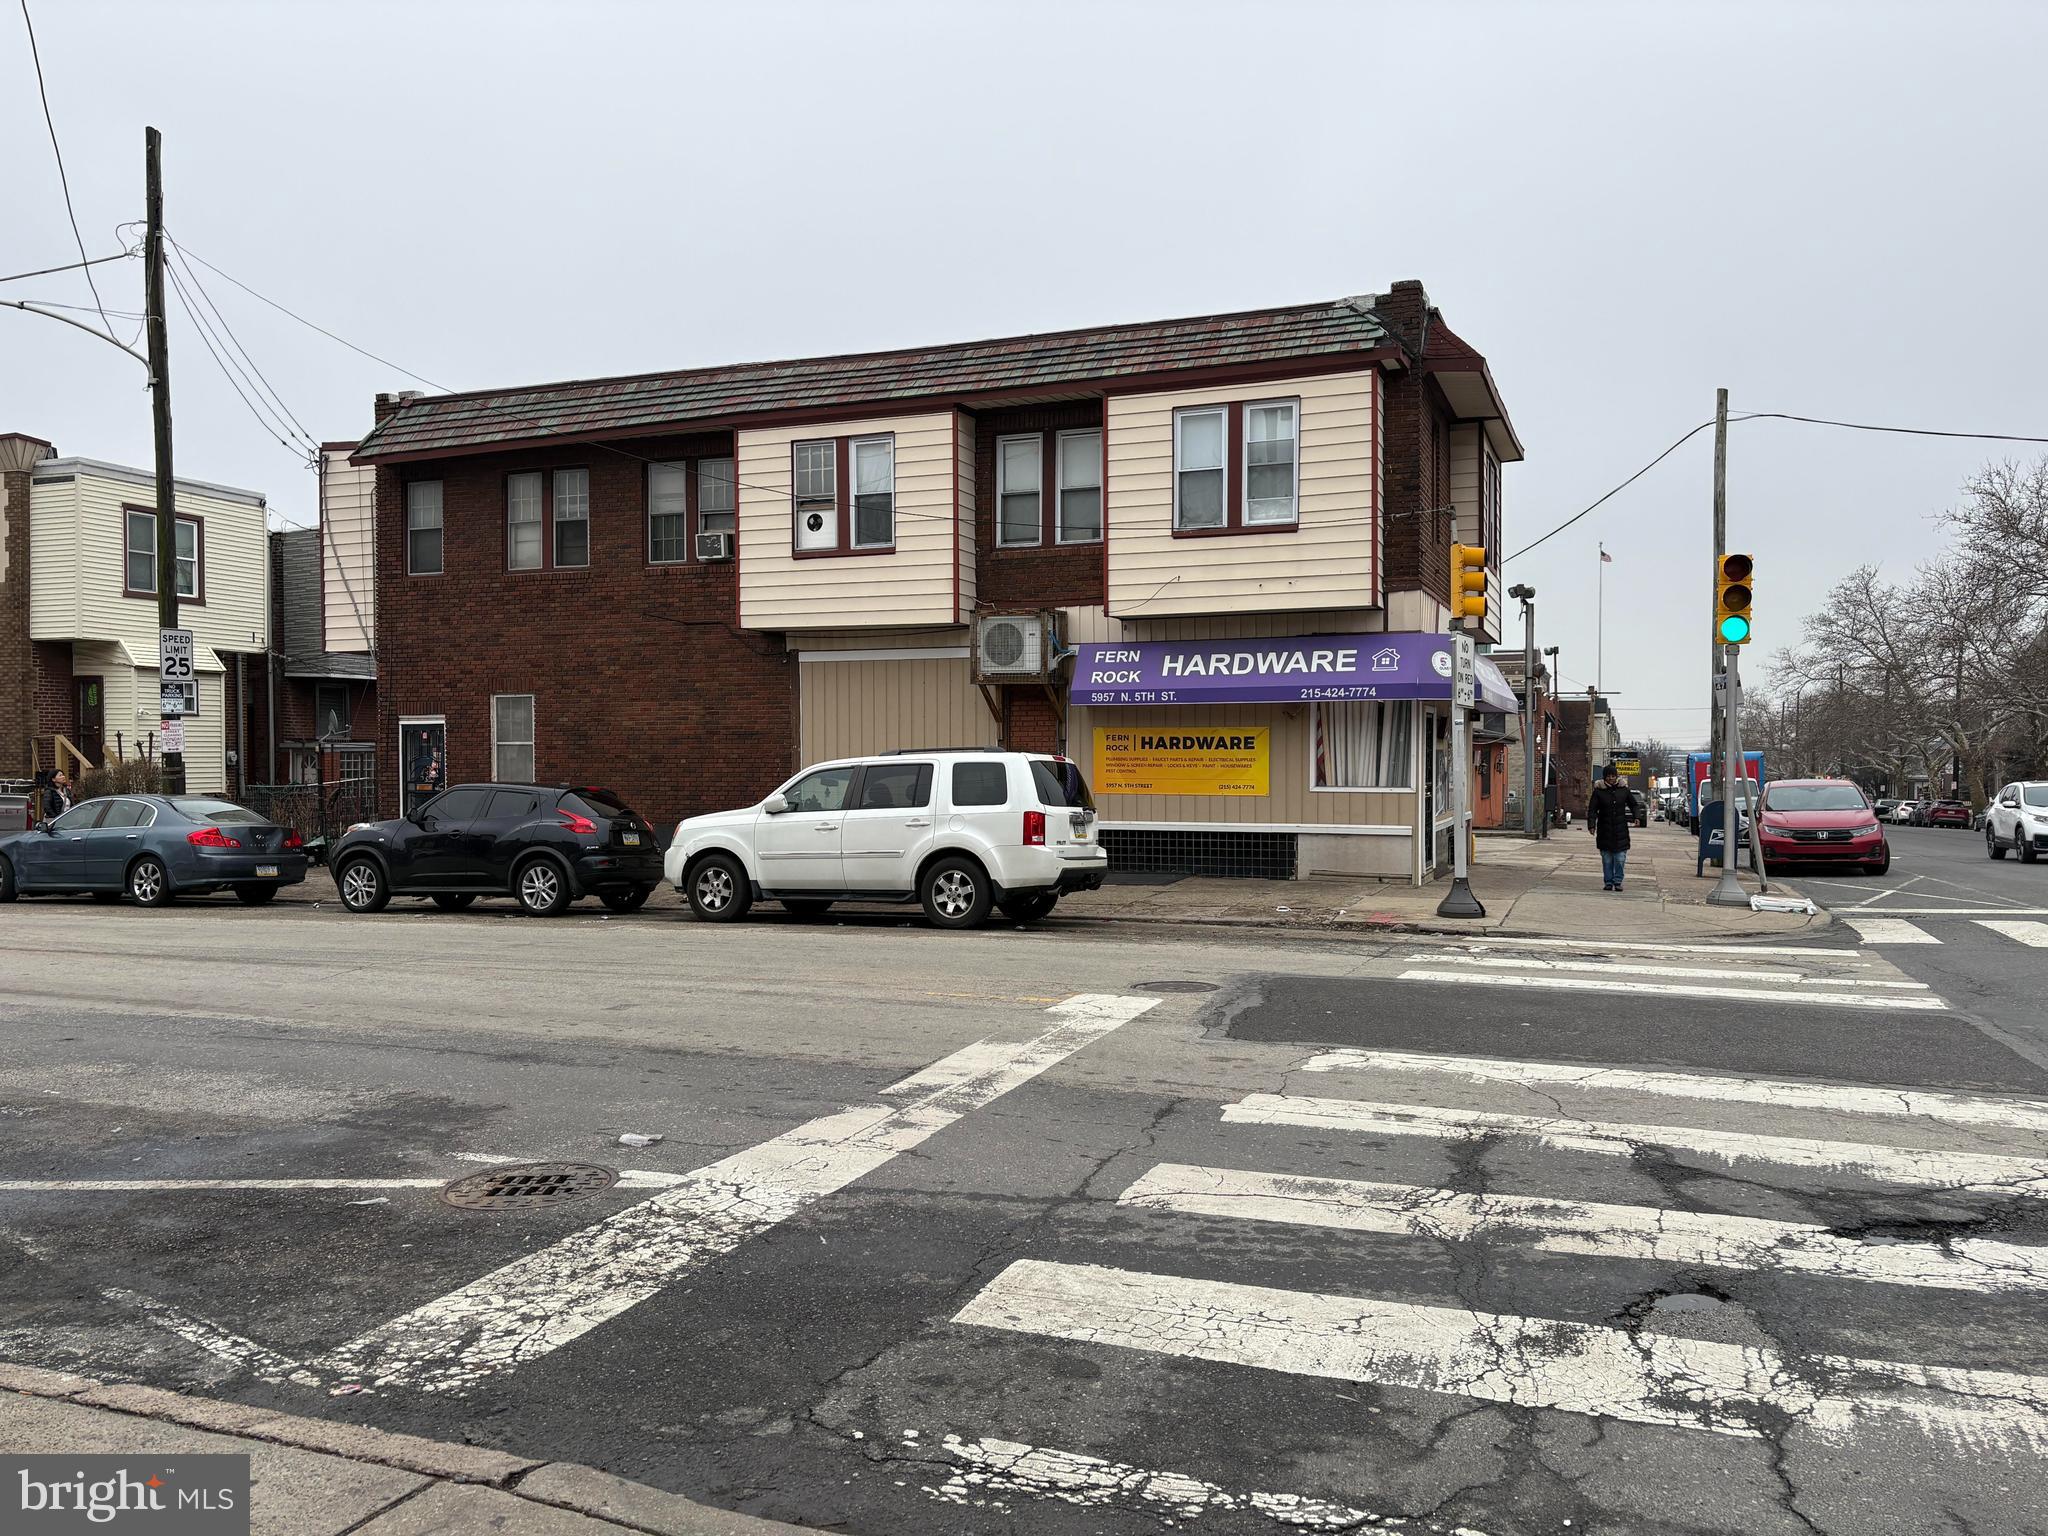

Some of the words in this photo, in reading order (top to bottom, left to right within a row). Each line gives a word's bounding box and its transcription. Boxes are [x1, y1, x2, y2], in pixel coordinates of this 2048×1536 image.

[162, 634, 191, 644] SPEED
[165, 645, 188, 655] LIMIT
[1461, 640, 1469, 654] NO
[1094, 650, 1141, 663] FERN
[1161, 649, 1358, 677] HARDWARE
[1460, 656, 1471, 669] TURN
[164, 656, 191, 677] 25
[1091, 670, 1142, 684] ROCK
[1458, 671, 1464, 684] ON
[1465, 673, 1474, 685] RED
[1091, 692, 1115, 702] 5957
[1120, 692, 1131, 702] N.
[1134, 691, 1155, 701] 5TH
[1161, 691, 1177, 701] ST.
[1300, 687, 1377, 699] 215-424-7774
[1140, 736, 1256, 750] HARDWARE
